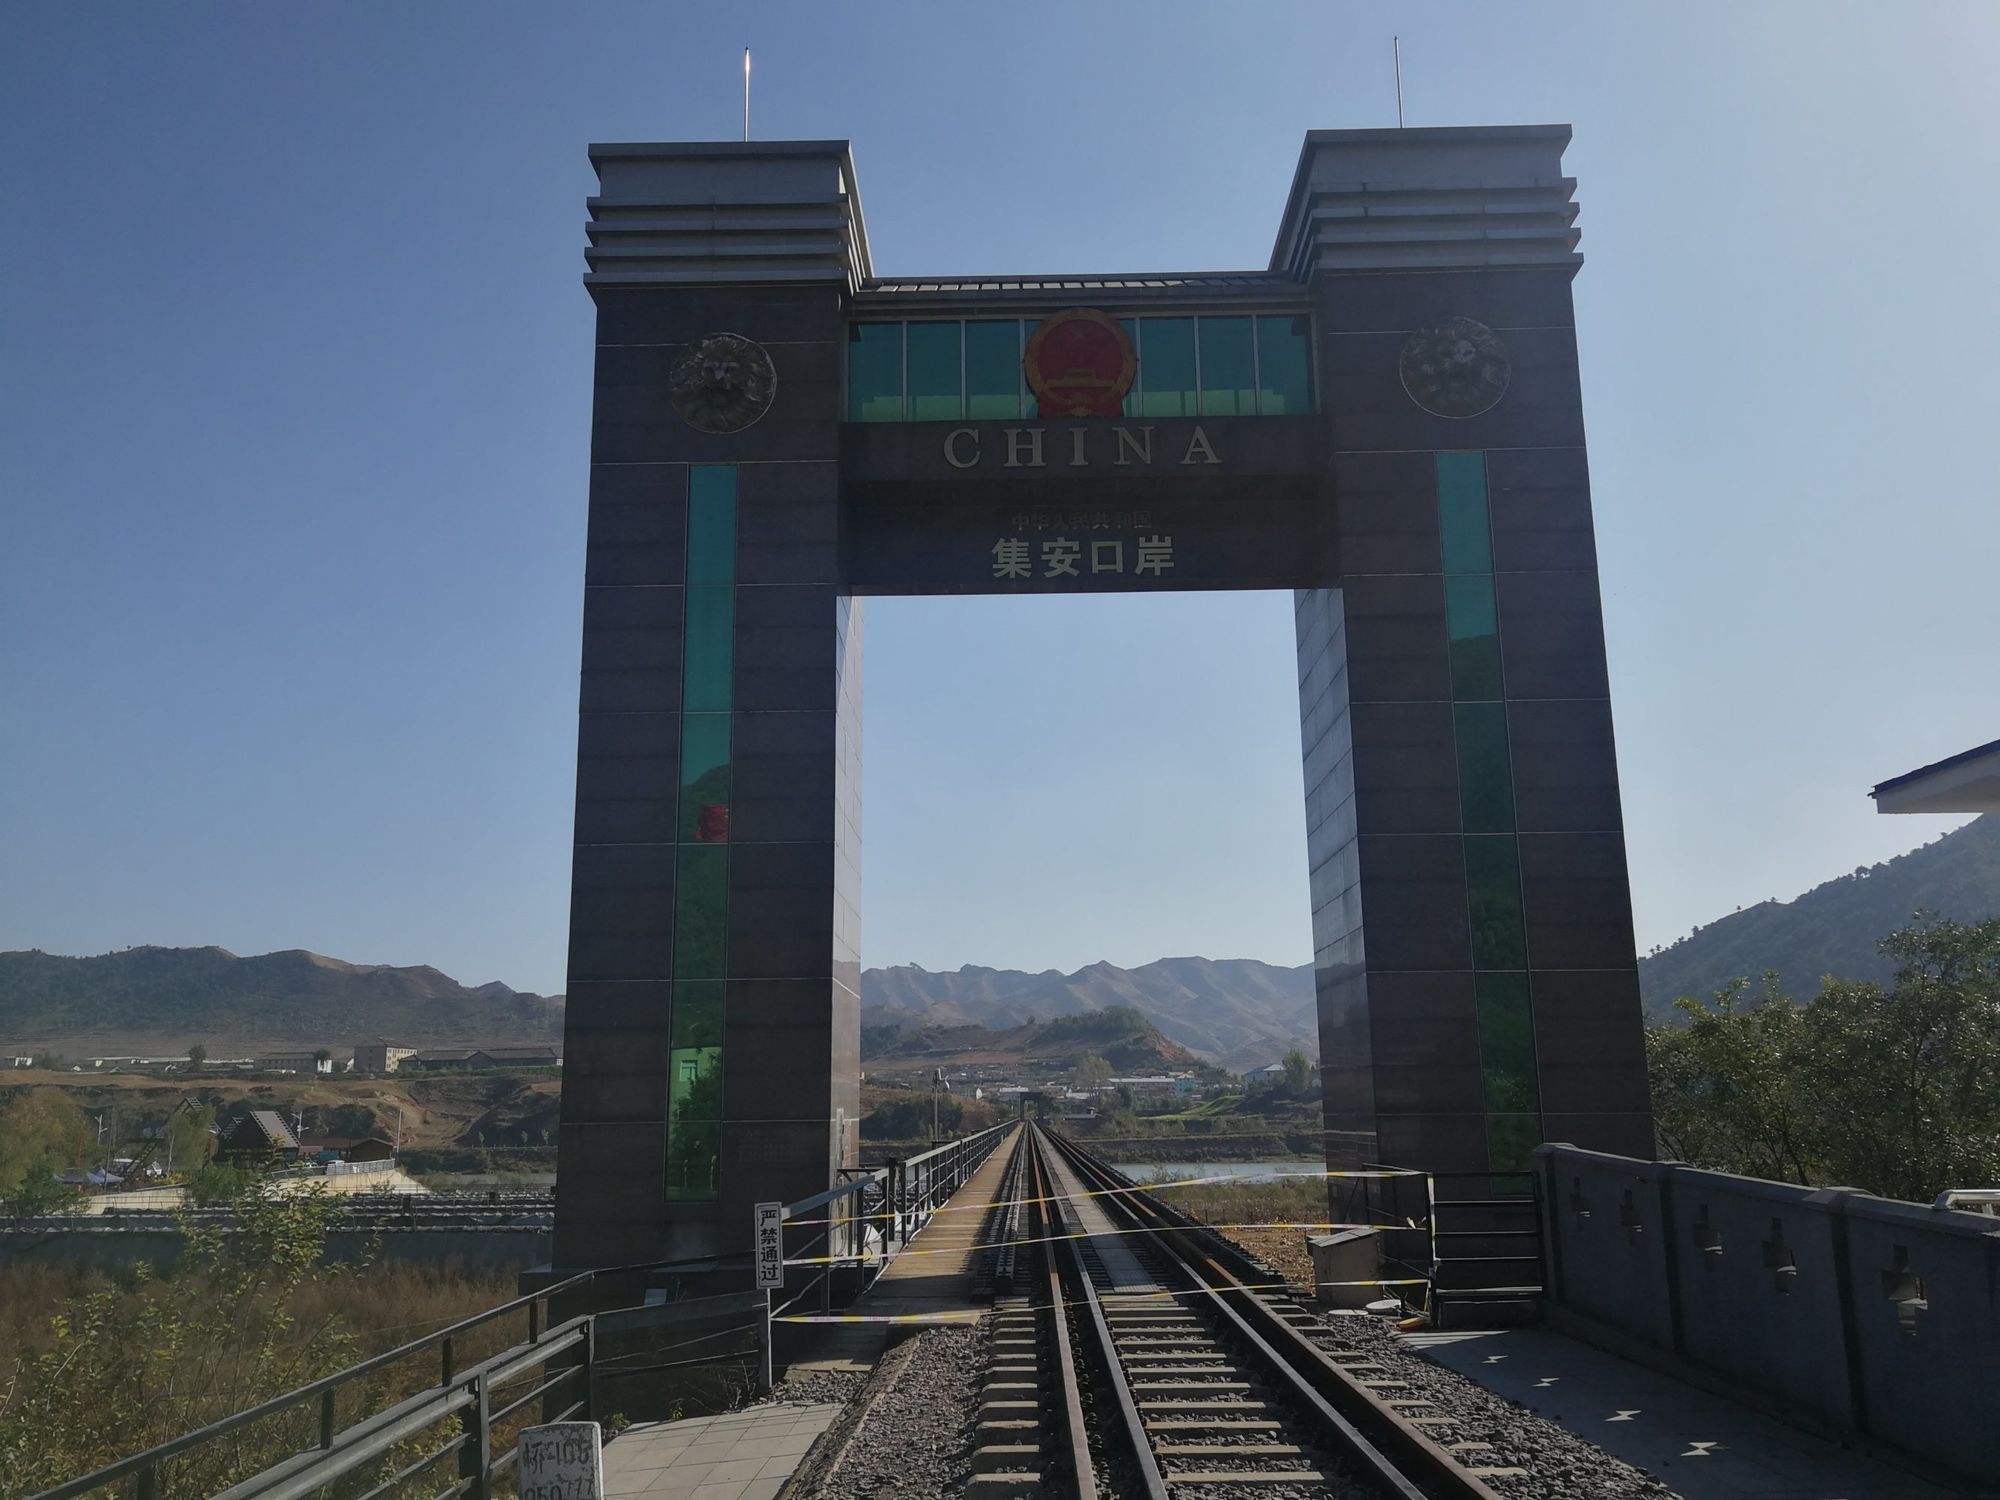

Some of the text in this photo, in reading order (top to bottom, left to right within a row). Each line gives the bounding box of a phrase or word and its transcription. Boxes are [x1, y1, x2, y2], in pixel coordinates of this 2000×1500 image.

[943, 425, 1223, 469] CHINA
[991, 534, 1175, 579] 集安口岸
[759, 1209, 779, 1282] 严禁通过
